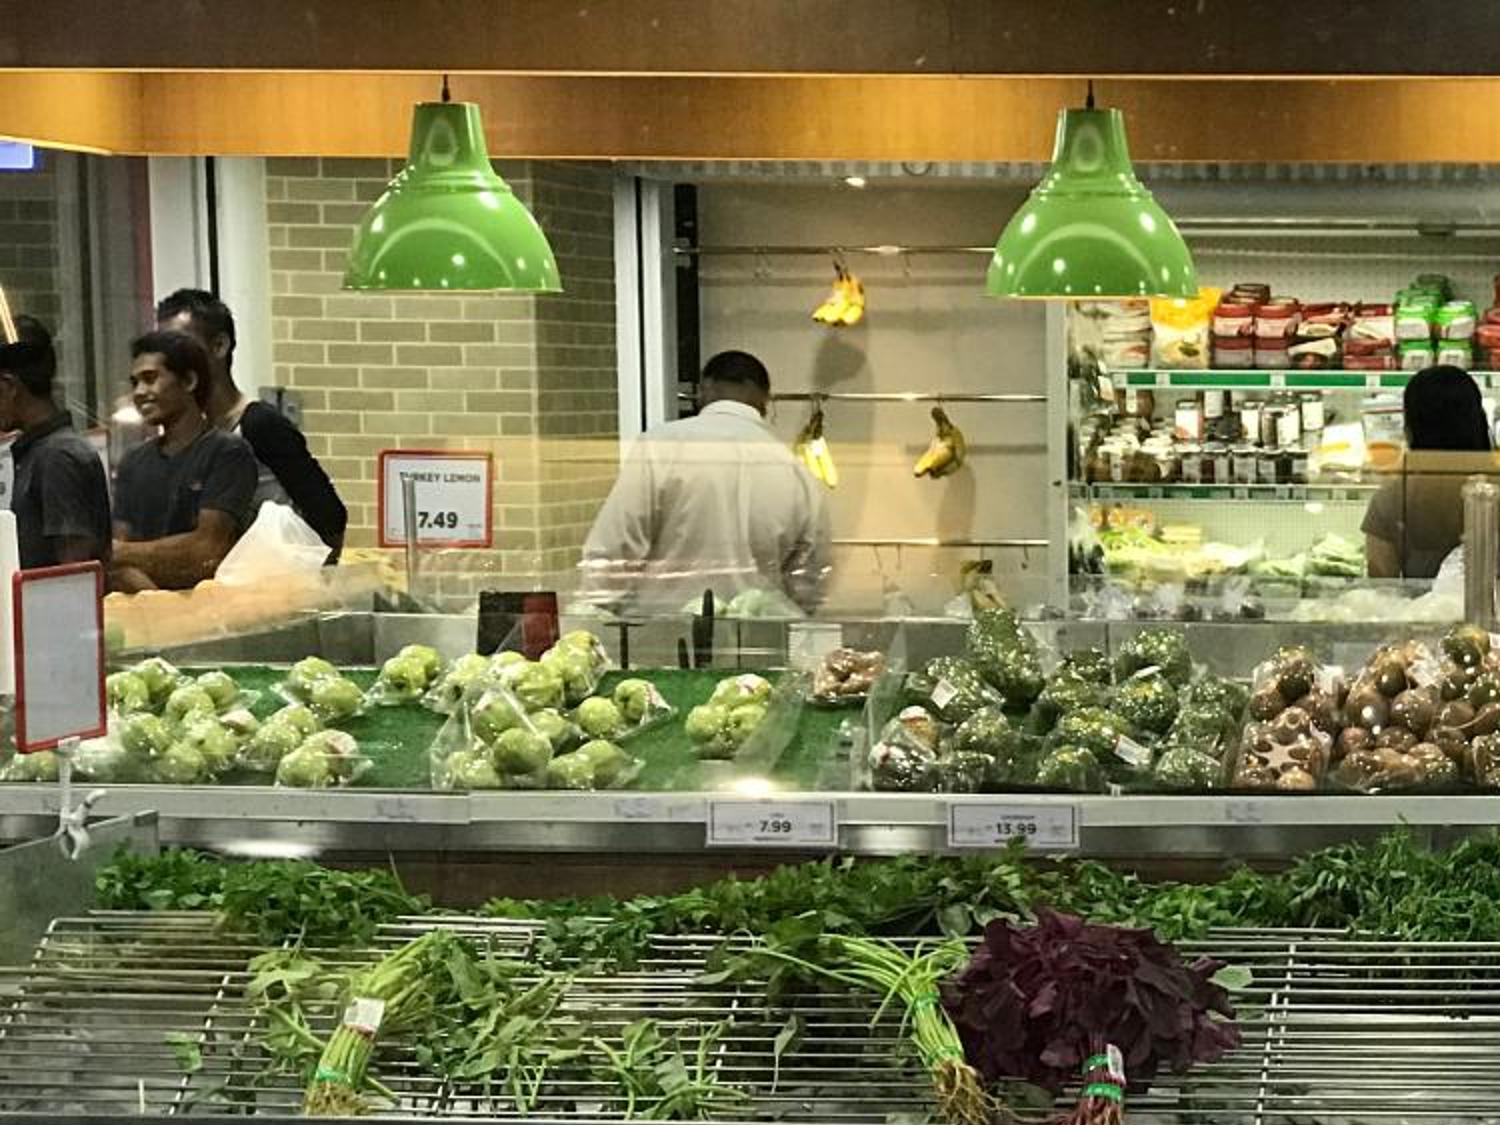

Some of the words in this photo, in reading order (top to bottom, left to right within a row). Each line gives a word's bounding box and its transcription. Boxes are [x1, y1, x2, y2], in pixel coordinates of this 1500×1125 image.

[418, 511, 458, 528] 7.49
[760, 820, 791, 833] 7.99
[996, 823, 1037, 835] 13.99
